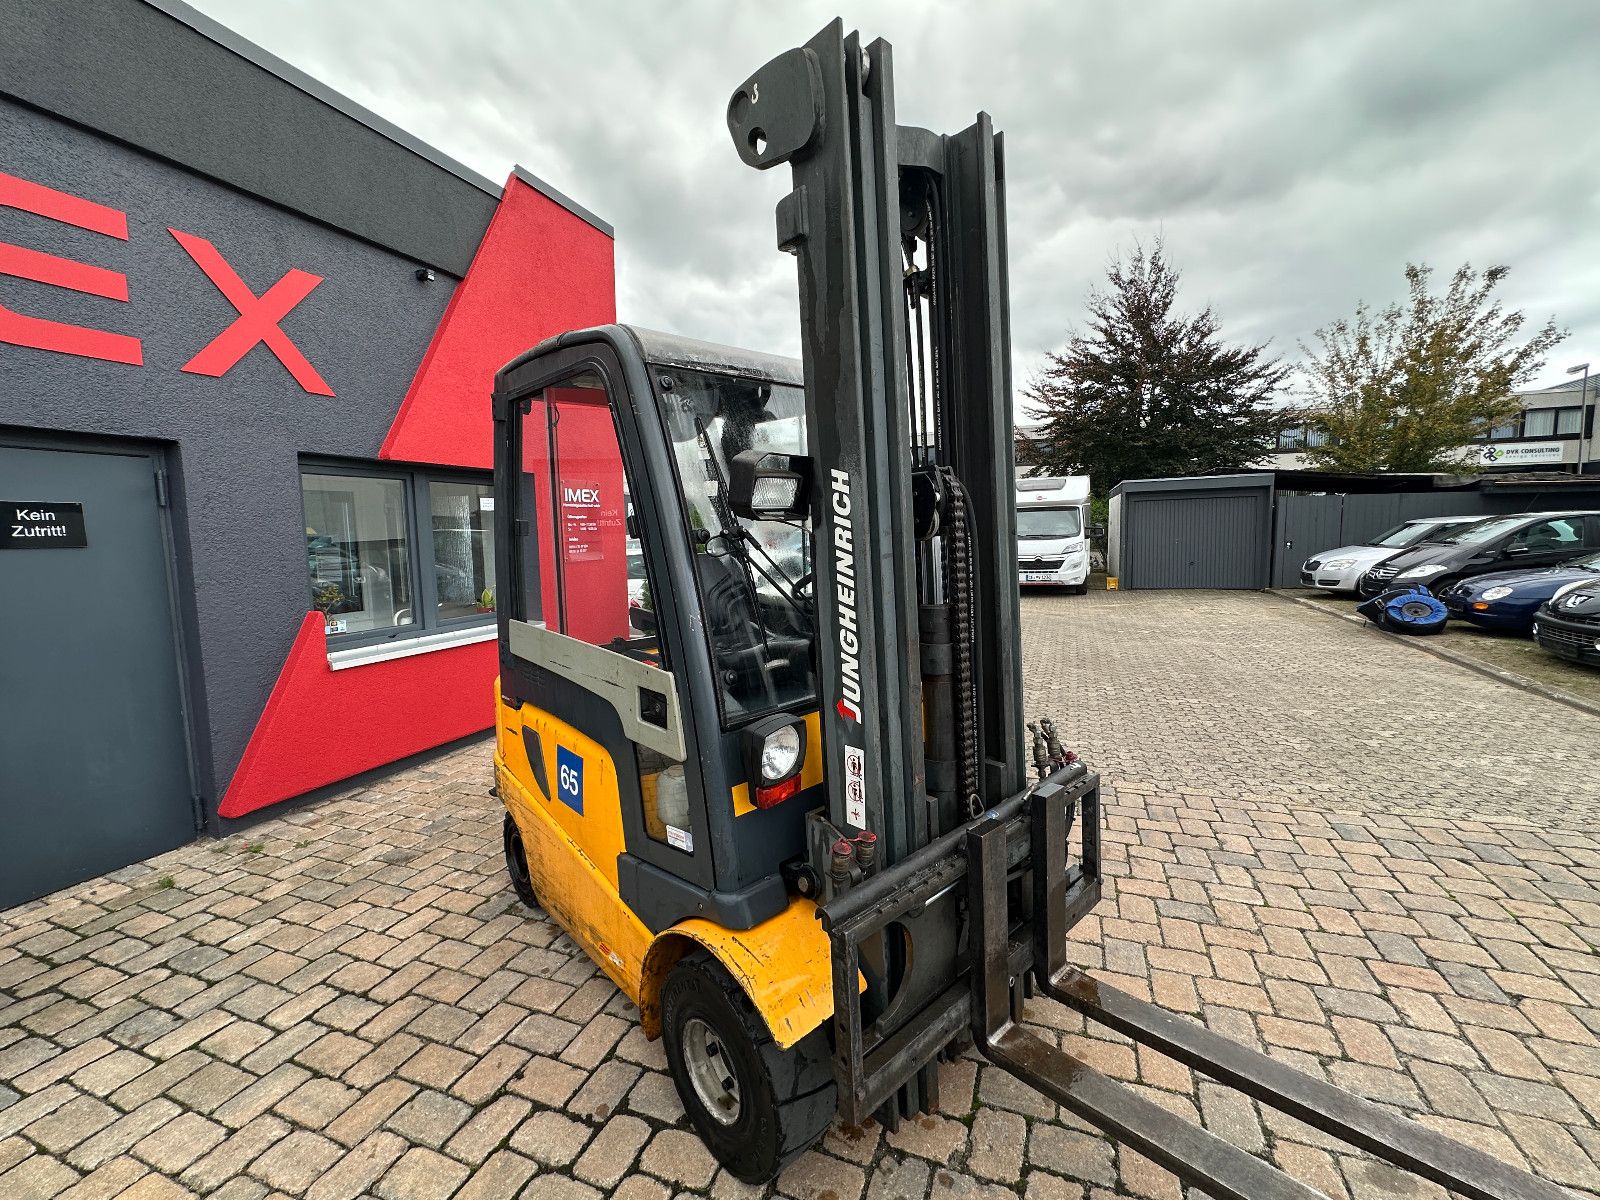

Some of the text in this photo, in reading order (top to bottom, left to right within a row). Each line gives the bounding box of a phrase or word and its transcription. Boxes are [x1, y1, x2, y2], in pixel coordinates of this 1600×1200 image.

[564, 487, 599, 502] IMEX
[16, 509, 56, 521] Kein
[11, 525, 67, 537] Zutritt!
[830, 467, 863, 725] JUNGHEINRICH
[561, 764, 579, 796] 65
